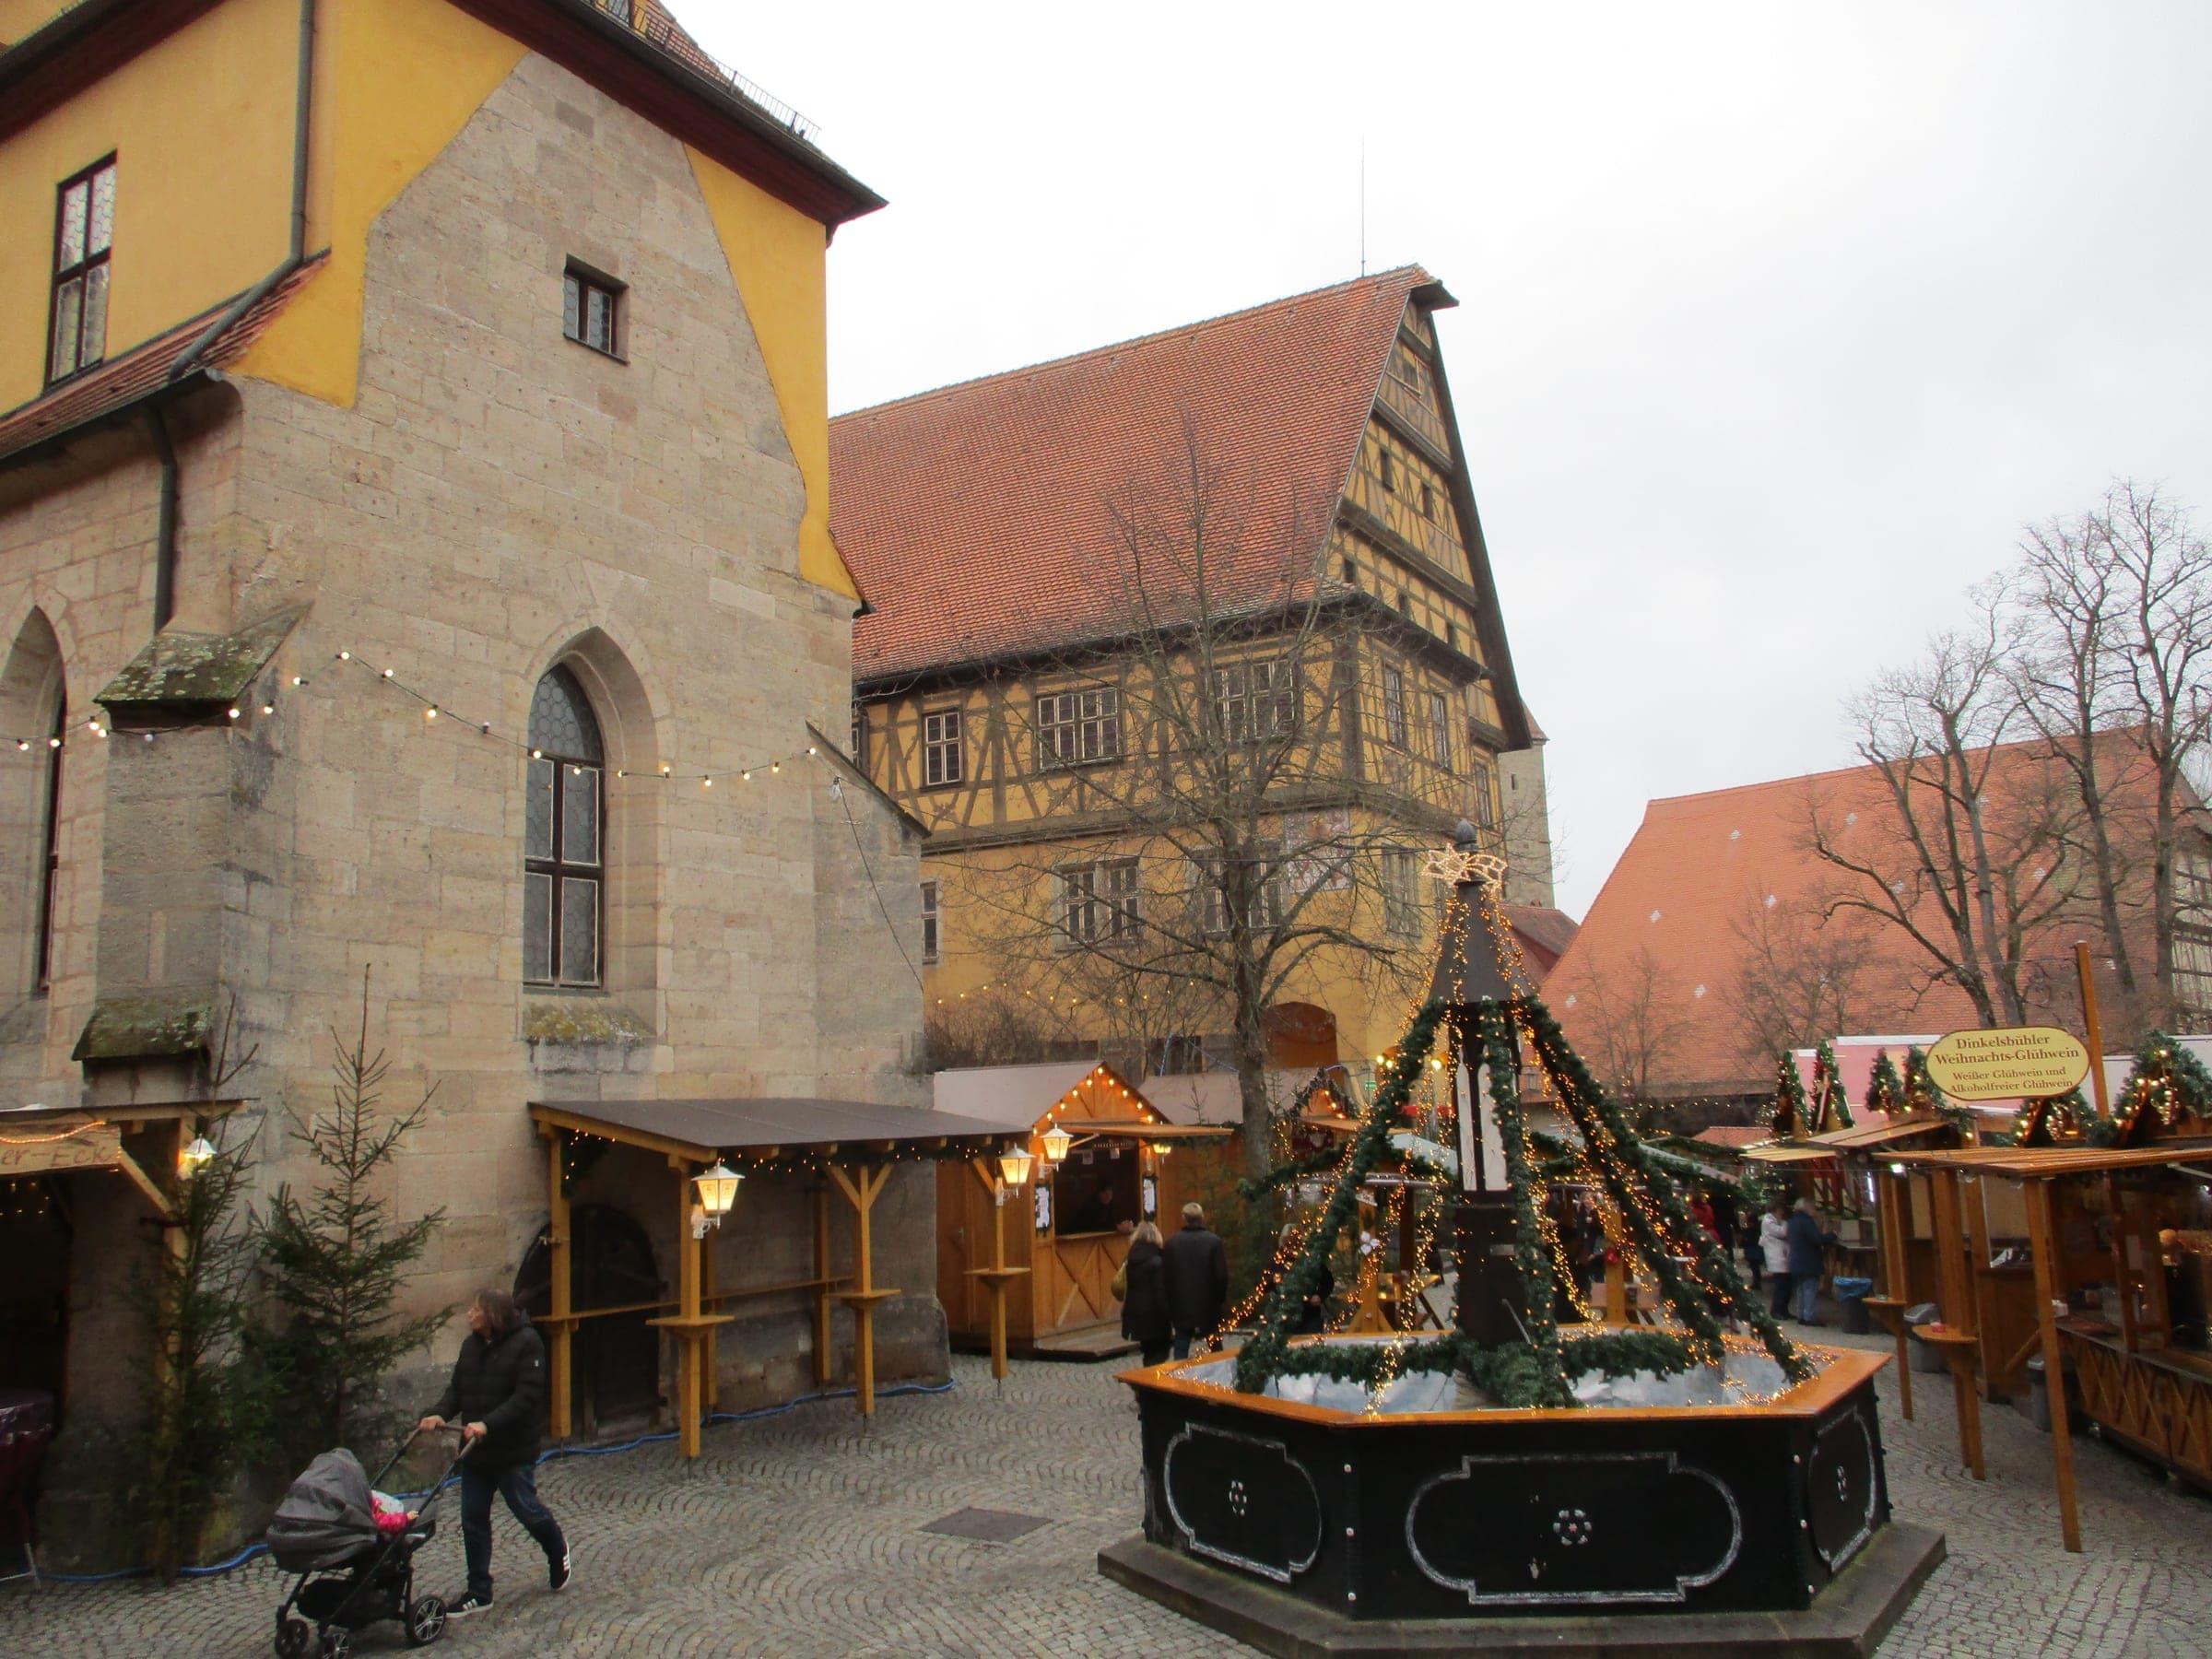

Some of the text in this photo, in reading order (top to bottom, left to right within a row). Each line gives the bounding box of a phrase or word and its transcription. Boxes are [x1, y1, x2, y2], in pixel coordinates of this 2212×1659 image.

[1956, 1034, 2051, 1050] Dinkelsbühler
[1935, 1047, 2079, 1065] Weihnachts-Glühwein
[1952, 1066, 2066, 1081] Weißer Glühwein und
[1949, 1079, 2073, 1093] Alkoholfreier Glühwein
